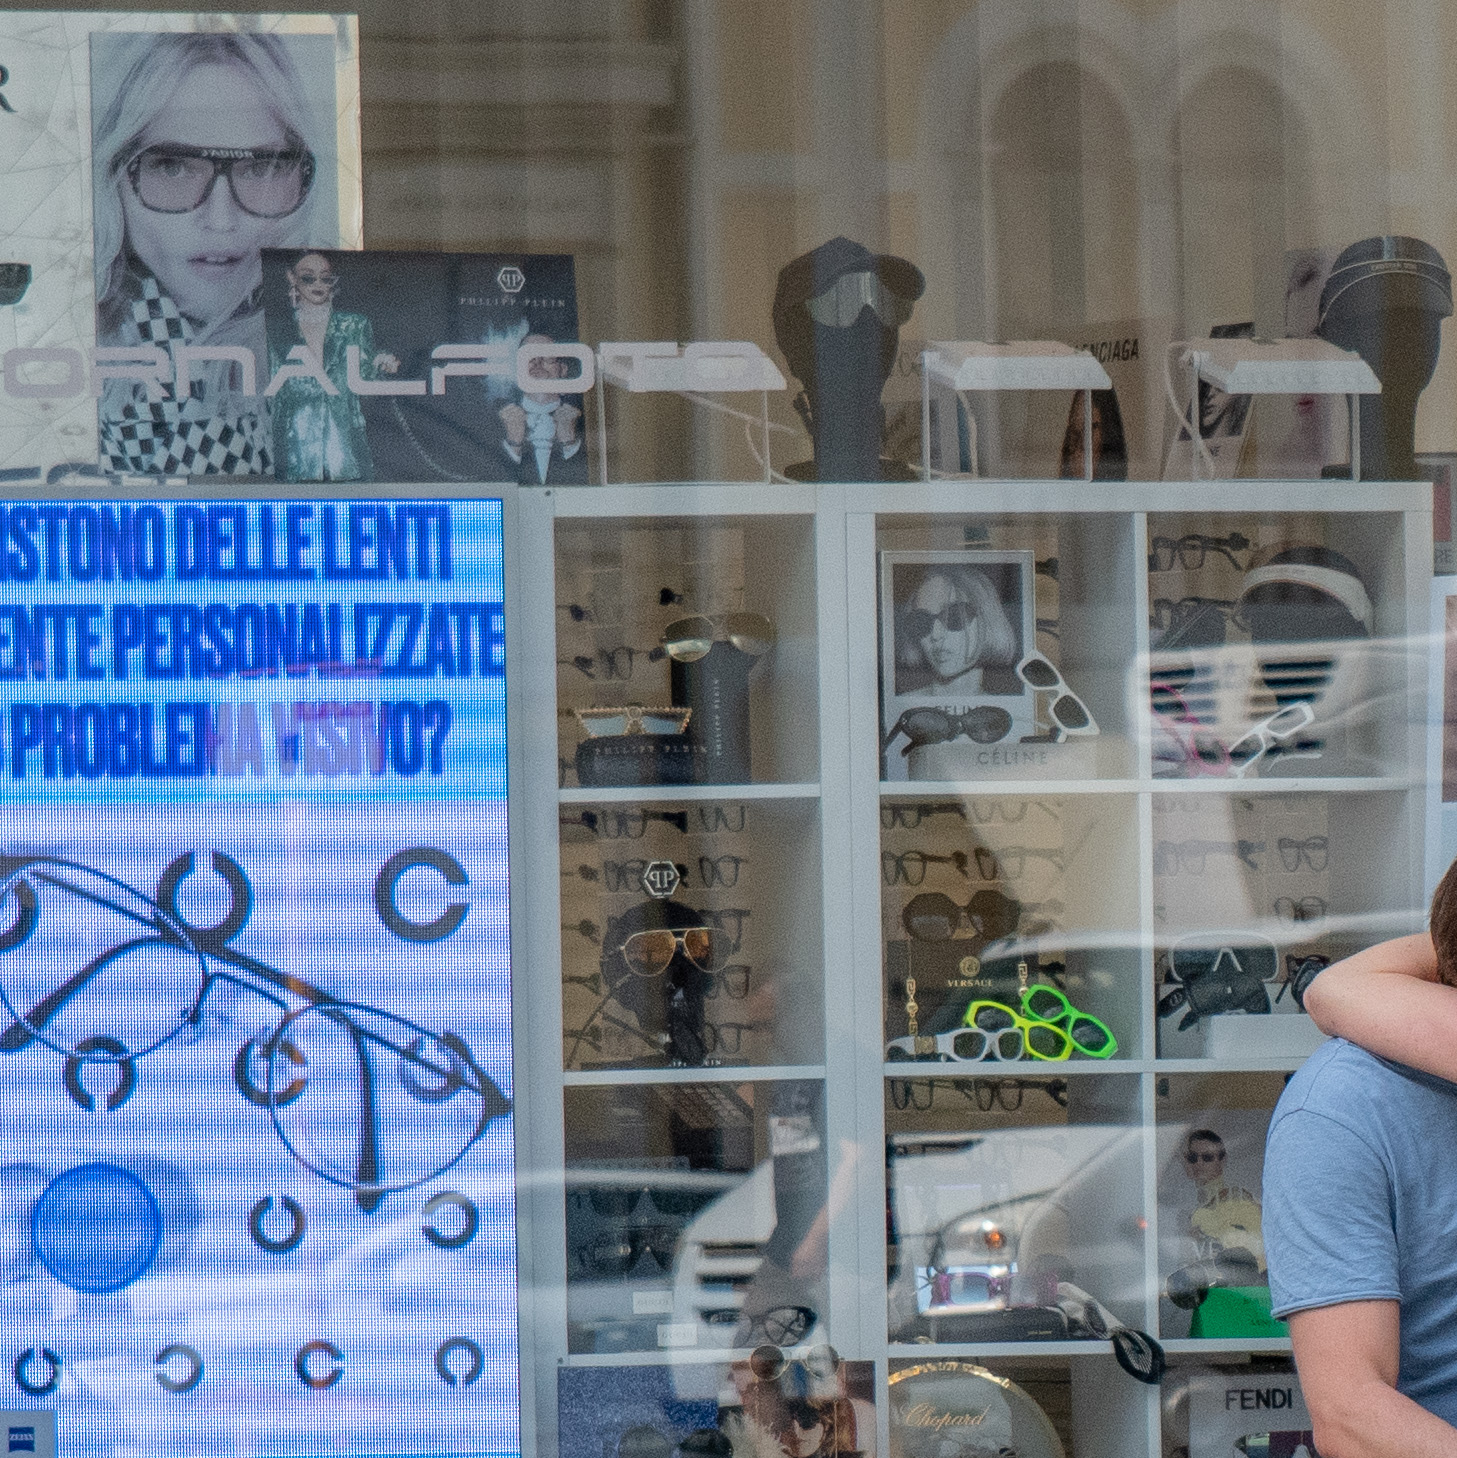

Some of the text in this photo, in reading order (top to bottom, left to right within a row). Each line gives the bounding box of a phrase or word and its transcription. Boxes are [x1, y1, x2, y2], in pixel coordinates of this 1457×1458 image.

[174, 504, 318, 580] DELLE
[324, 504, 452, 580] LENTI
[112, 601, 506, 680] PERSONALIZZATE
[11, 700, 451, 779] PROBLEMA VISIVO?
[905, 1402, 992, 1432] Chopard
[1225, 1387, 1293, 1411] FENDI
[9, 1433, 35, 1442] ZEISS
